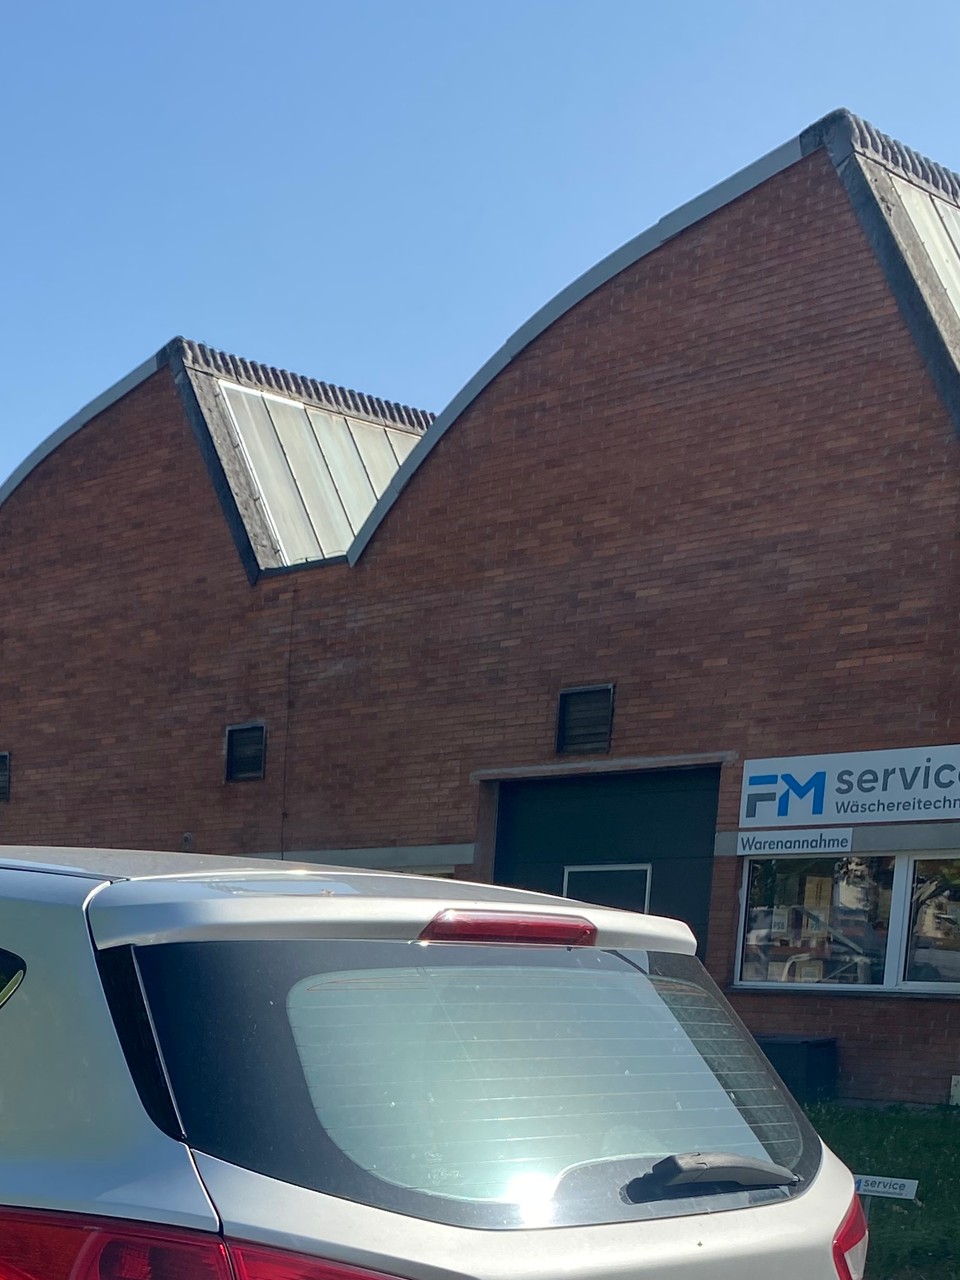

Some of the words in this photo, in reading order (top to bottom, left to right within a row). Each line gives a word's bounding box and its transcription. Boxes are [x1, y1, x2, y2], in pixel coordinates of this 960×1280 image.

[745, 771, 827, 818] FM
[835, 757, 960, 795] servic
[740, 833, 849, 851] Warenannahme
[863, 1179, 906, 1191] service
